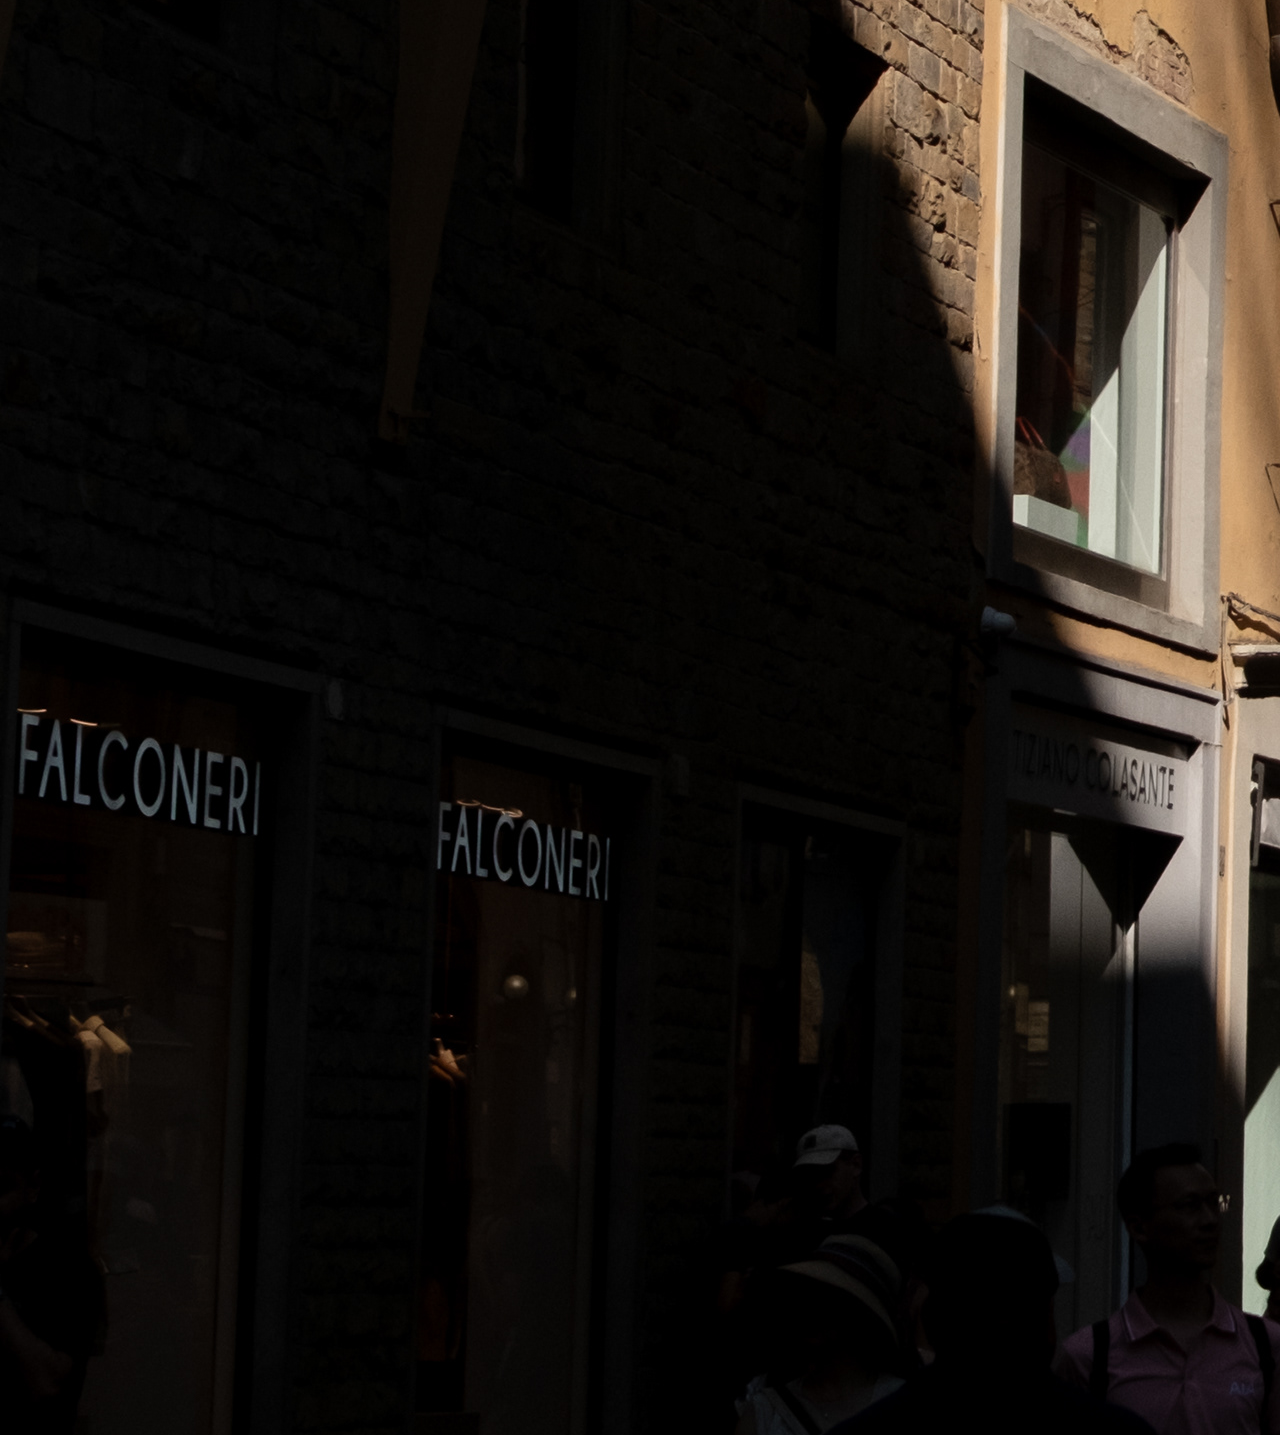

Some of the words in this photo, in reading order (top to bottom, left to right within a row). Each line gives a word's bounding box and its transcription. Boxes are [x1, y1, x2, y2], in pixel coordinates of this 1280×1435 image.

[17, 713, 262, 837] FALCONERI
[1012, 728, 1079, 787] TIZIANO
[1084, 744, 1175, 810] COLASANTE
[436, 799, 612, 902] FALCONERI
